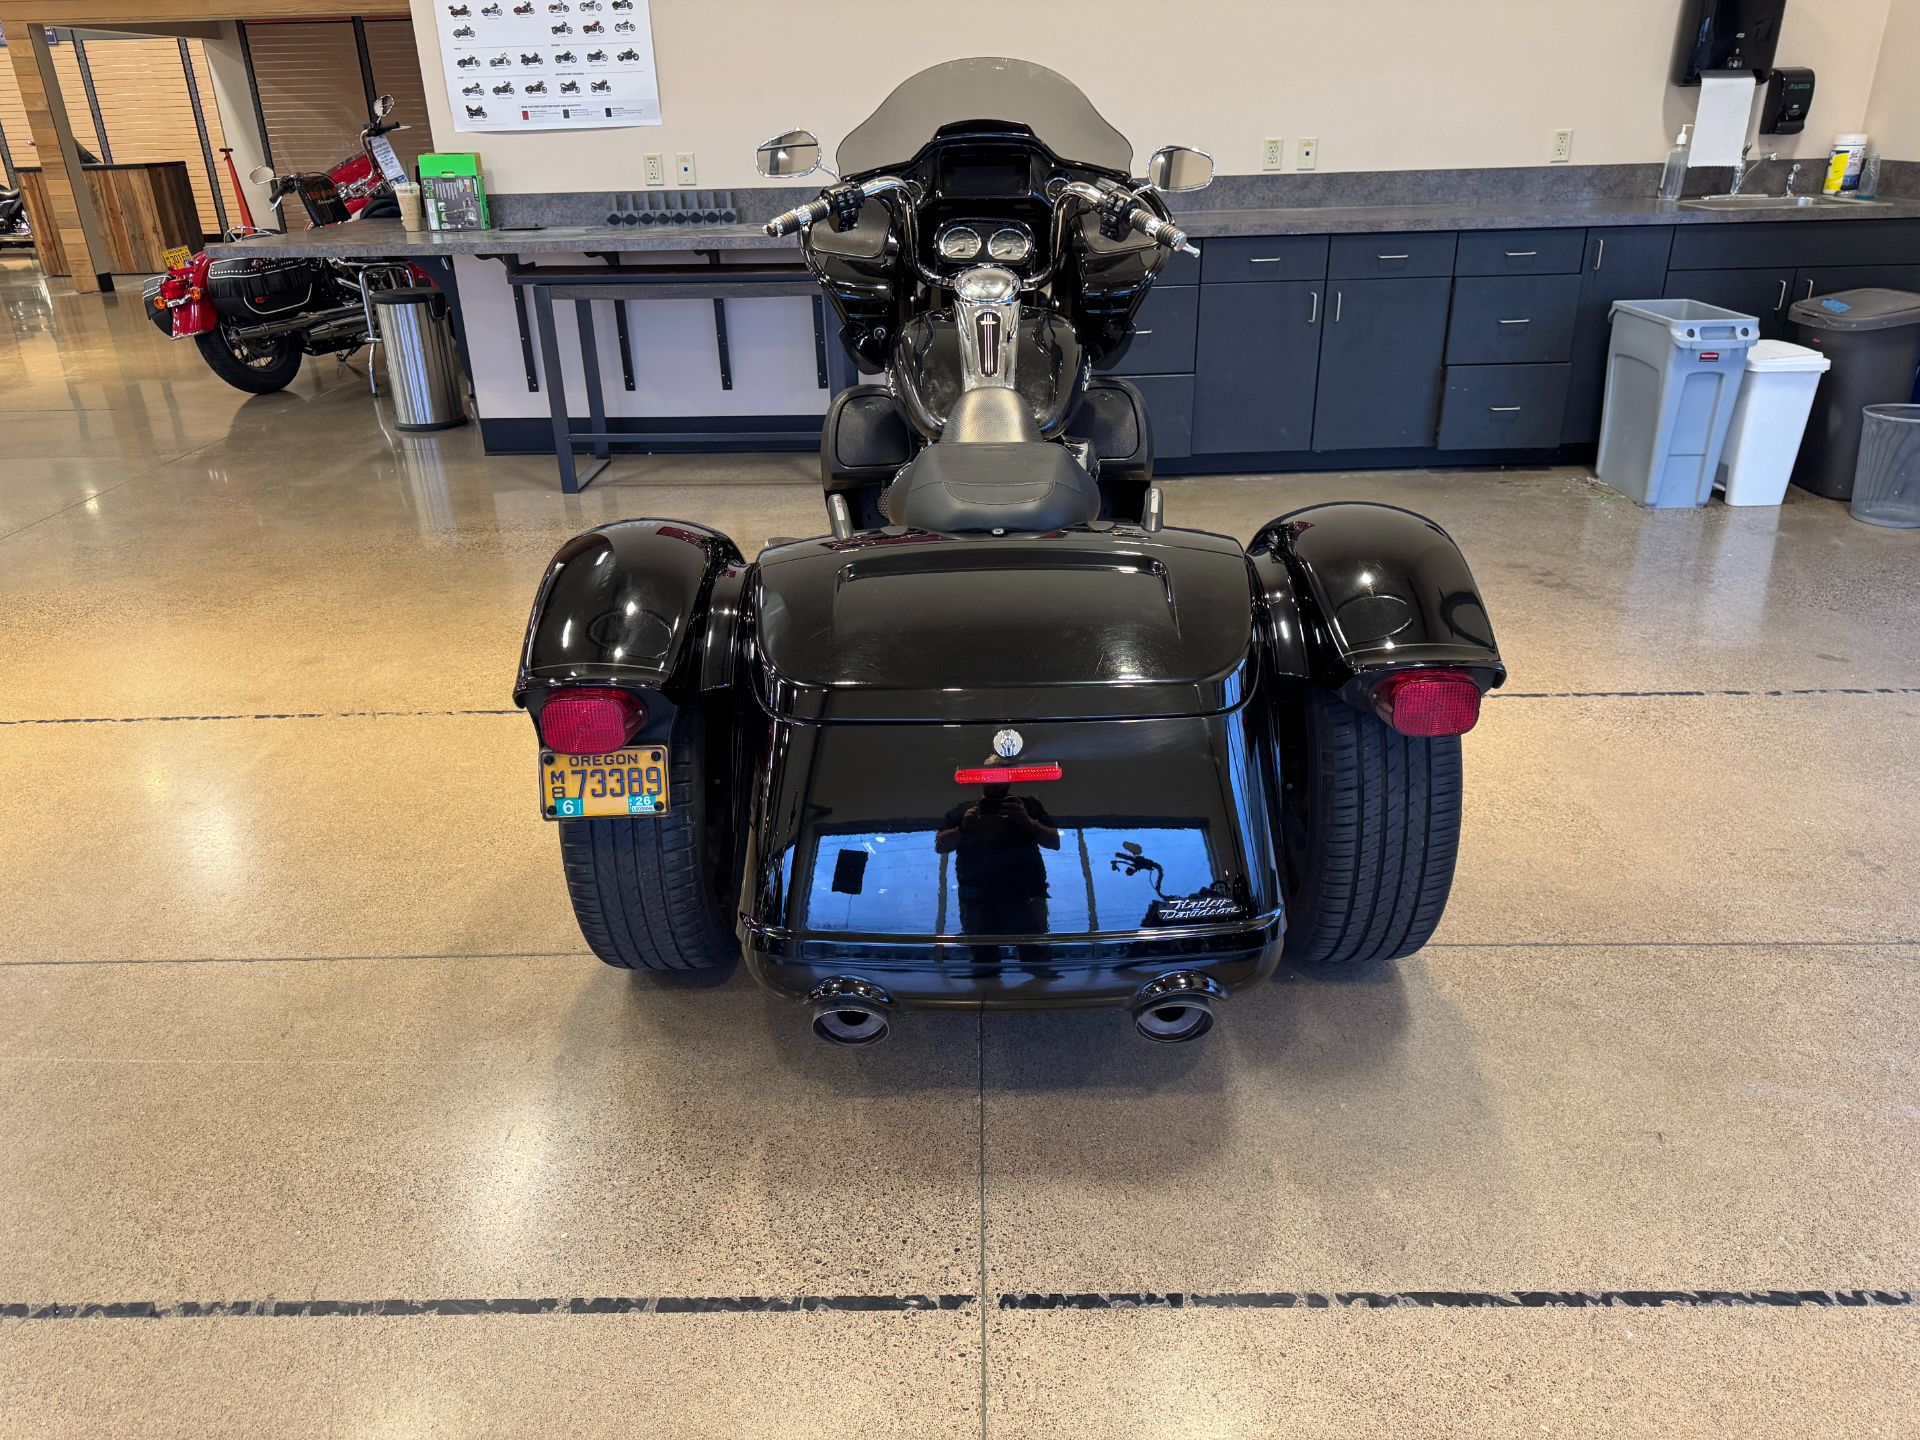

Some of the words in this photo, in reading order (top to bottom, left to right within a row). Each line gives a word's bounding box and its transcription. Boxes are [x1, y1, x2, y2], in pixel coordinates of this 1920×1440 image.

[569, 754, 638, 766] OREGON
[571, 767, 662, 798] 73389
[563, 800, 574, 814] 6
[636, 796, 651, 805] 26
